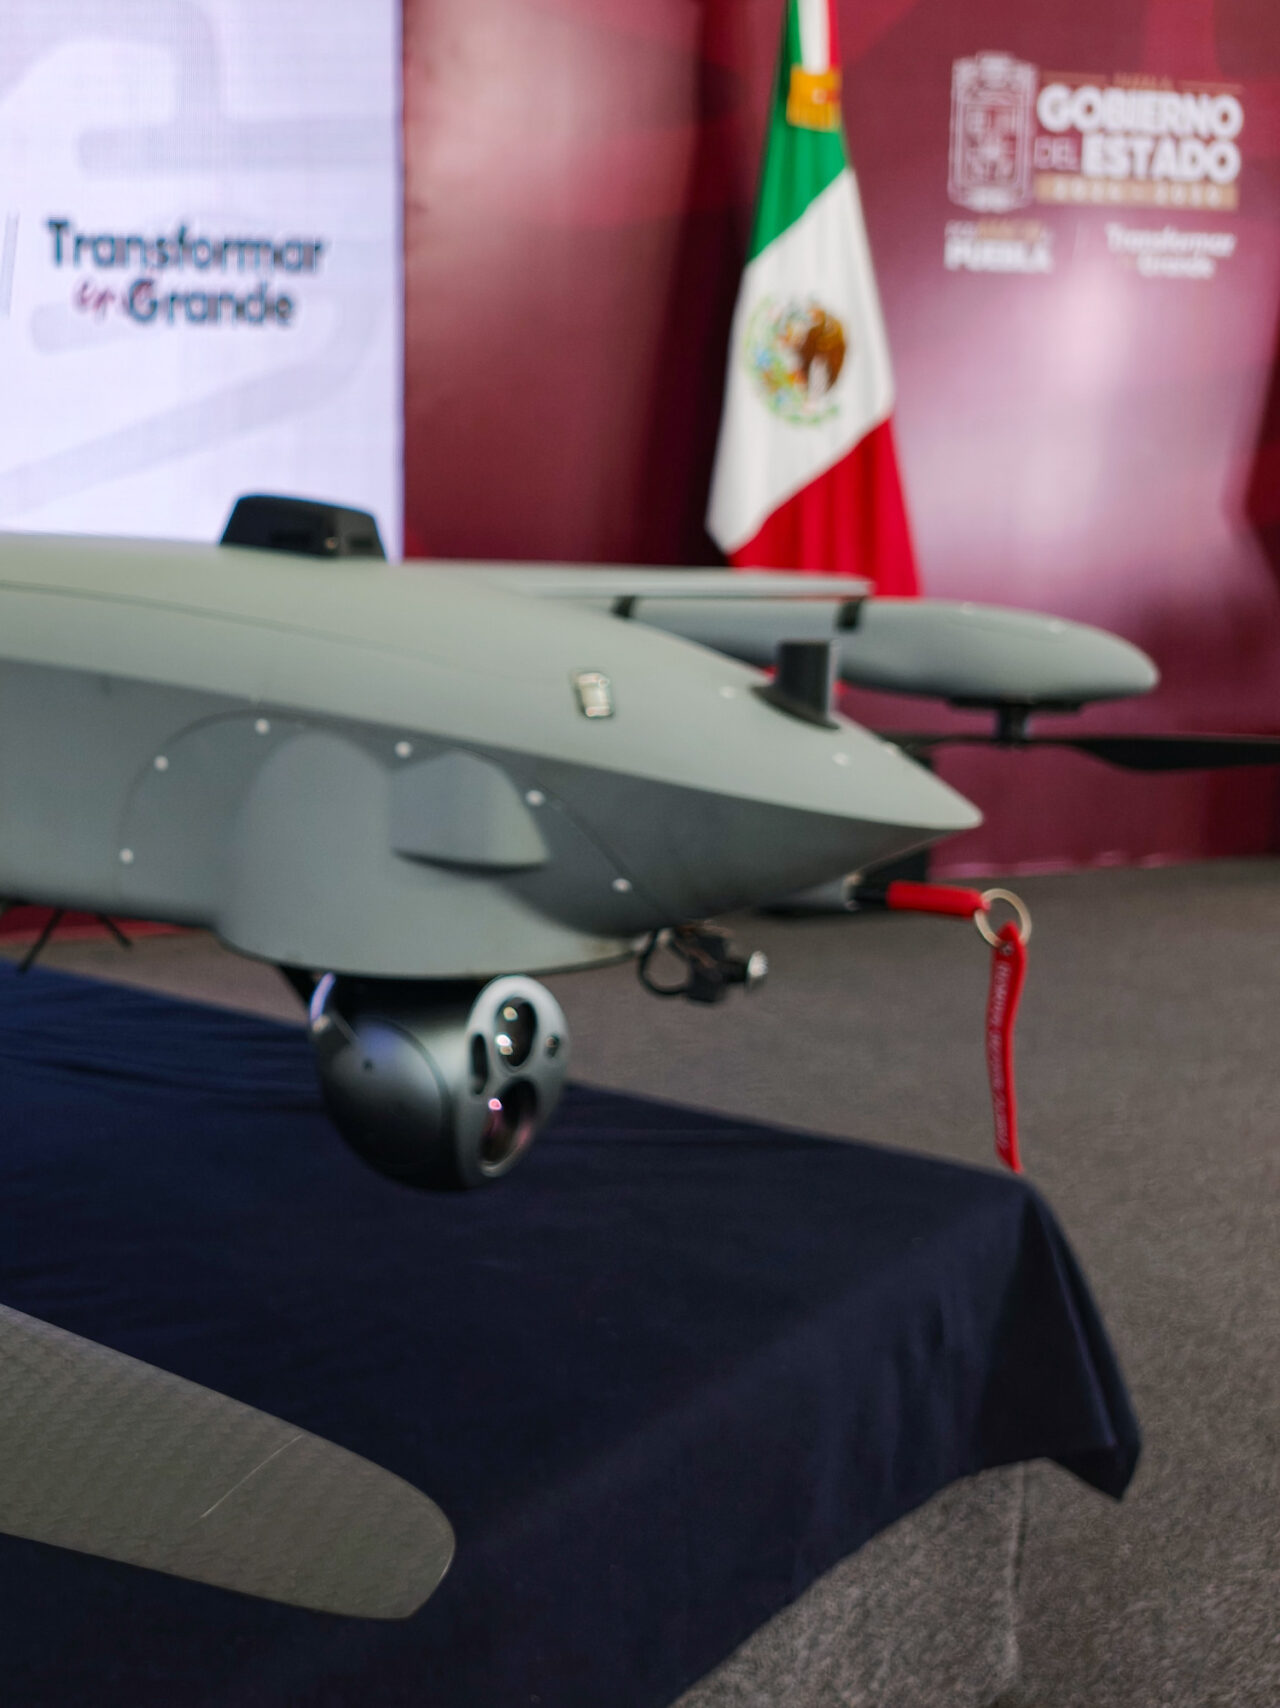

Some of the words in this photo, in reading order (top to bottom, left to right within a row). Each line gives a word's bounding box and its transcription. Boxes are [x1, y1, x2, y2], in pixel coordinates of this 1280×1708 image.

[1037, 83, 1243, 140] GOBIERNO
[1082, 132, 1241, 184] ESTADO
[46, 216, 326, 273] Transformar
[126, 277, 295, 326] Grande
